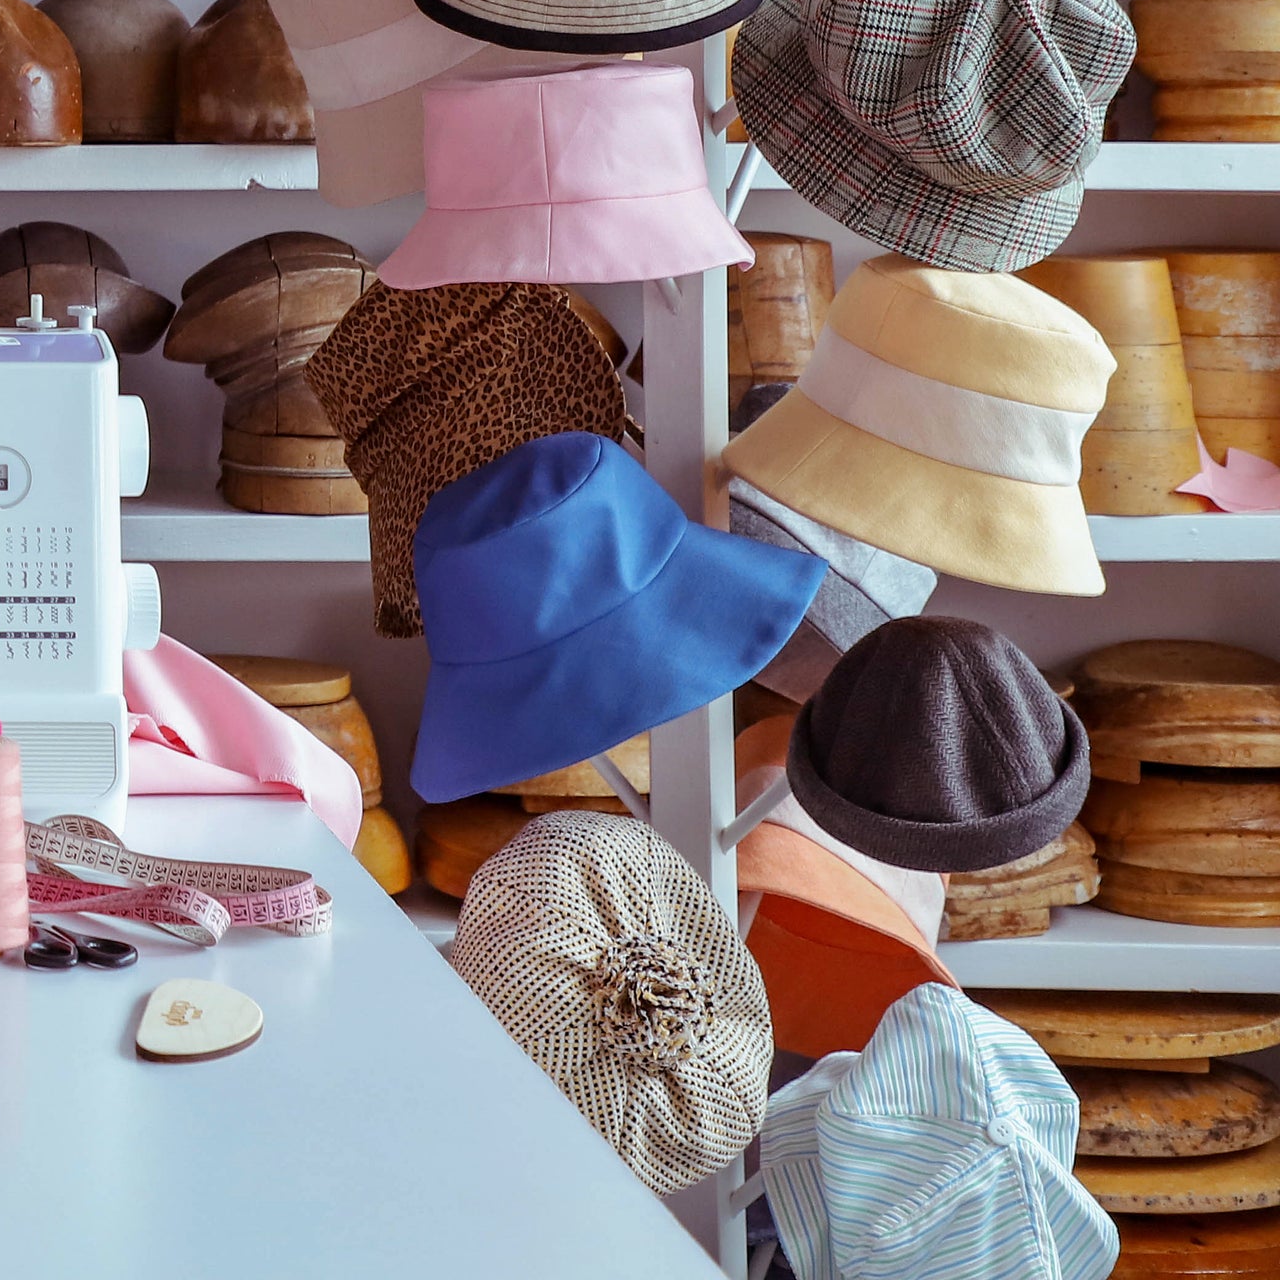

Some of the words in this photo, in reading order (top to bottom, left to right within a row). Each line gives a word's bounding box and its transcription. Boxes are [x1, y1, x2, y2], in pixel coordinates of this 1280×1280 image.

[82, 848, 96, 864] 42
[100, 853, 114, 867] 41
[117, 858, 133, 875] 40
[175, 889, 191, 905] 23
[193, 897, 209, 914] 24
